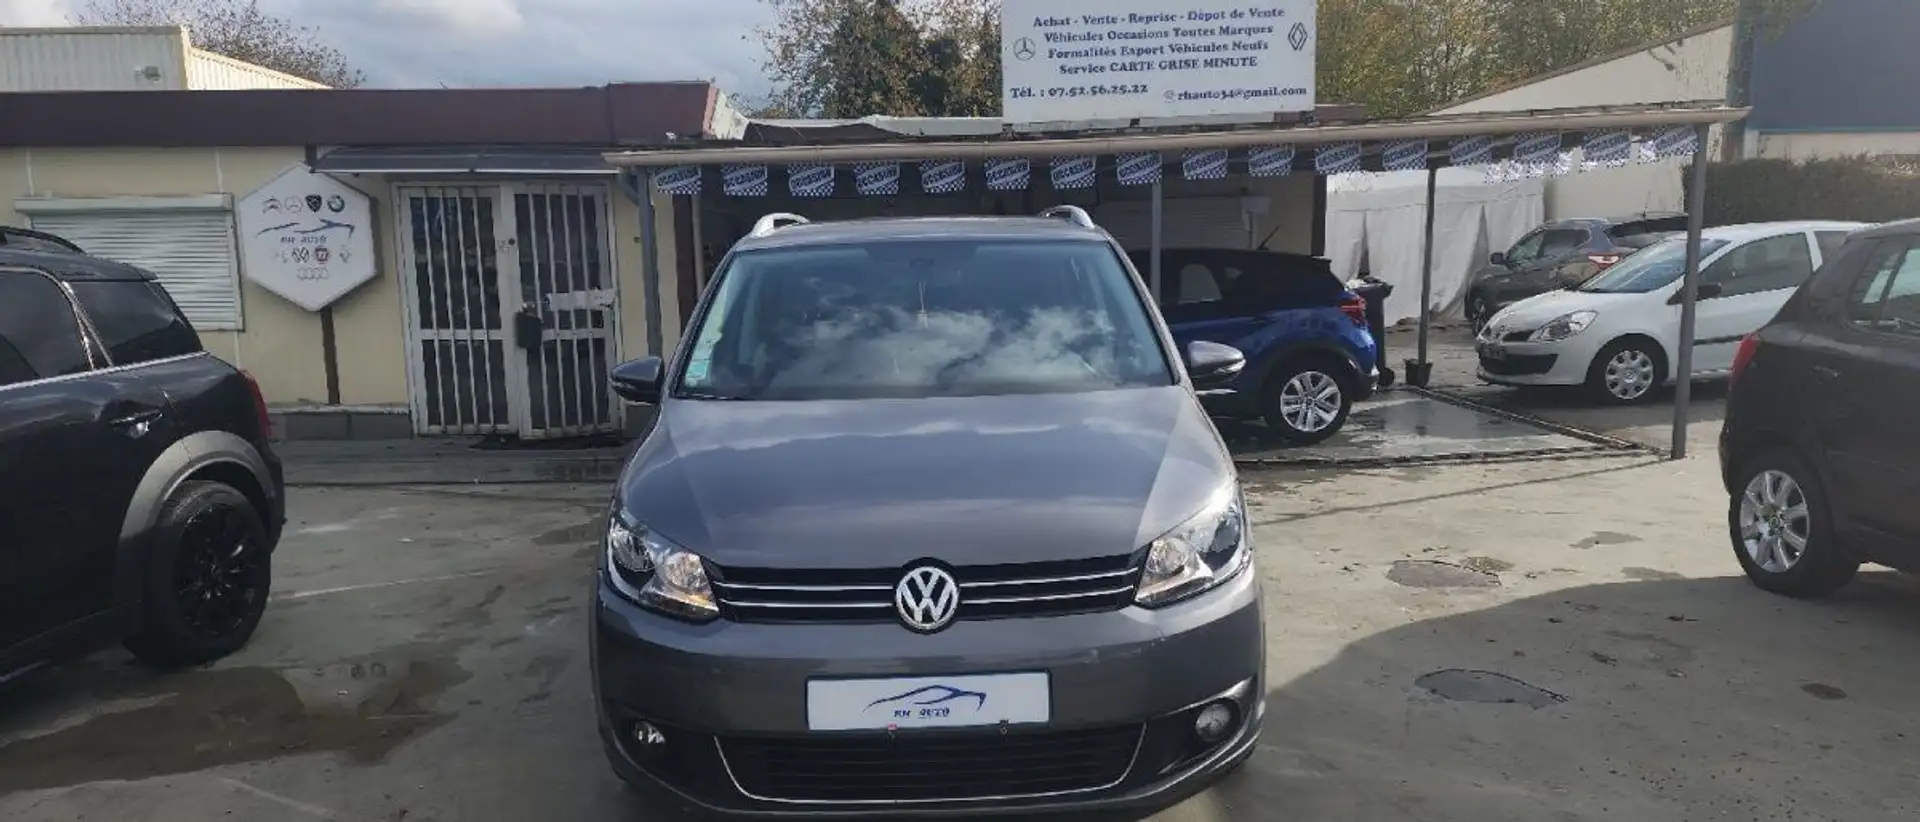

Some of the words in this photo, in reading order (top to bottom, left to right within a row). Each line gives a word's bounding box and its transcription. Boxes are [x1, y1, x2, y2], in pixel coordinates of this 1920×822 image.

[1033, 15, 1070, 27] Achat
[1082, 14, 1118, 25] Vente
[1128, 12, 1176, 25] Reprise
[1230, 9, 1245, 19] de
[1249, 7, 1285, 18] Vente
[1044, 31, 1103, 42] Véhicules
[1107, 28, 1168, 40] Occasions
[1172, 26, 1215, 37] Toutes
[1218, 24, 1274, 36] Marques
[1048, 46, 1116, 58] Formalités
[1119, 45, 1164, 57] Export
[1168, 41, 1228, 53] Véhicules
[1231, 40, 1269, 50] Neufs
[1059, 64, 1106, 75] Service
[1110, 61, 1155, 72] CARTE
[1158, 58, 1200, 70] GRISE
[1203, 56, 1258, 68] MINUTE
[1010, 87, 1036, 98] Tél.
[656, 166, 698, 186] OCCASION
[1052, 159, 1096, 180] OCCASION
